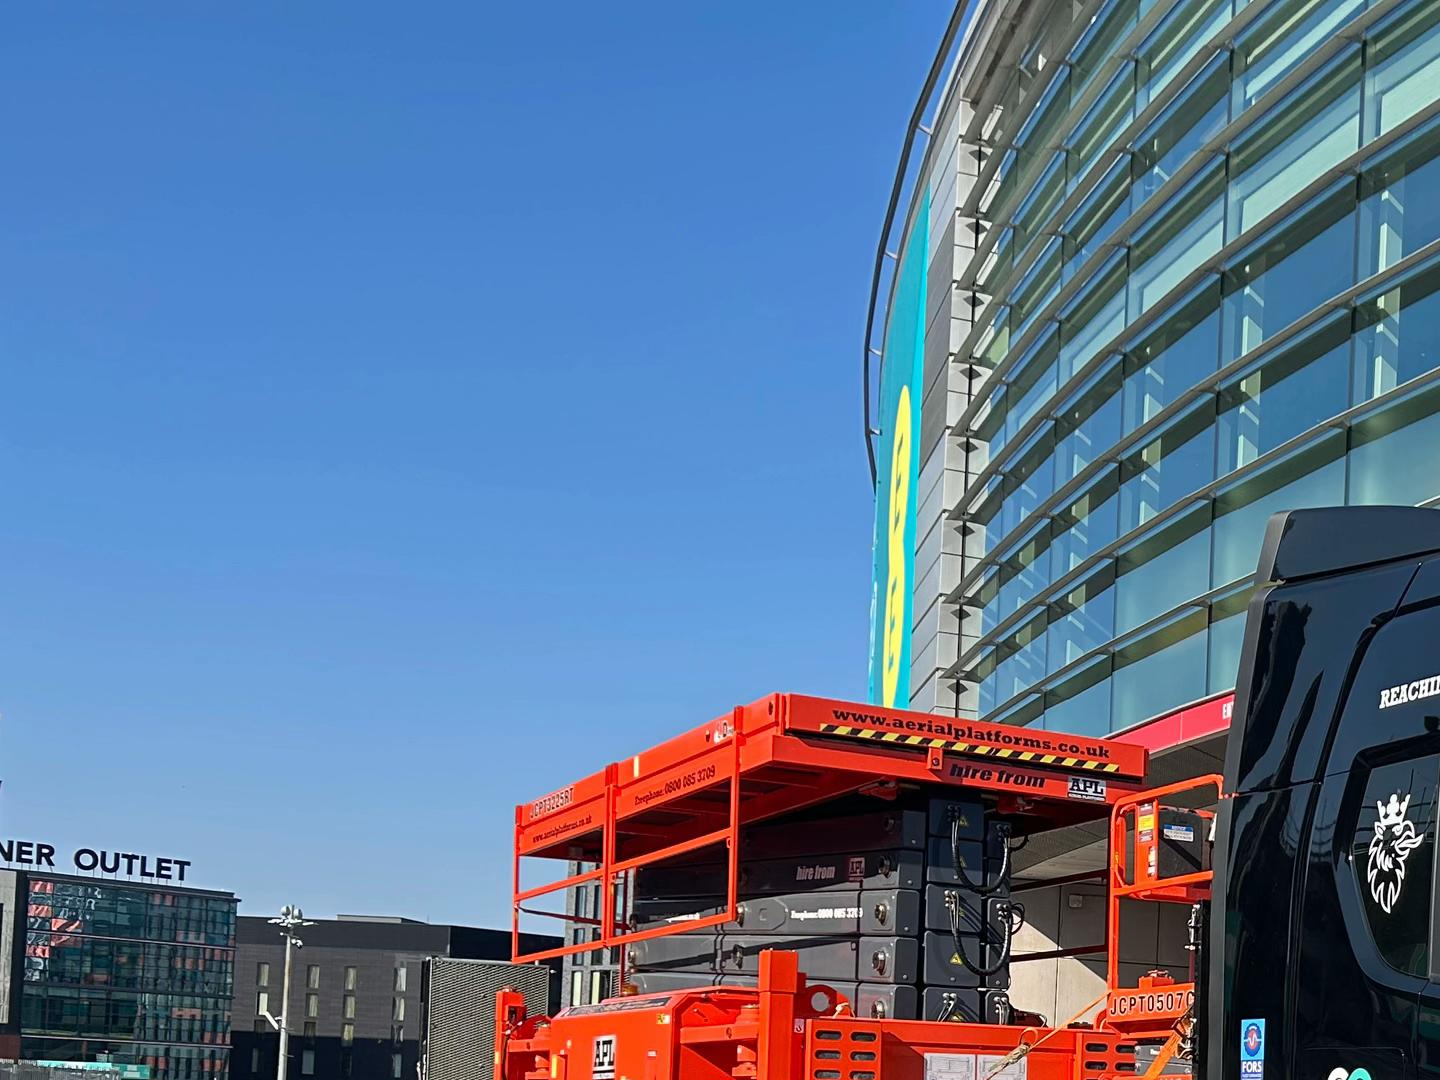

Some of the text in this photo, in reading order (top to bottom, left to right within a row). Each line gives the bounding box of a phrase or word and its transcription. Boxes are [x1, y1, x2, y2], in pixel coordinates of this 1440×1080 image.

[832, 708, 1110, 759] www.aerialplatforms.co.uk
[949, 763, 1046, 789] hire from
[1070, 777, 1104, 795] APL
[74, 848, 192, 881] OUTLET
[796, 864, 836, 881] hire from
[594, 1039, 615, 1068] APL
[1241, 1060, 1262, 1073] FORS
